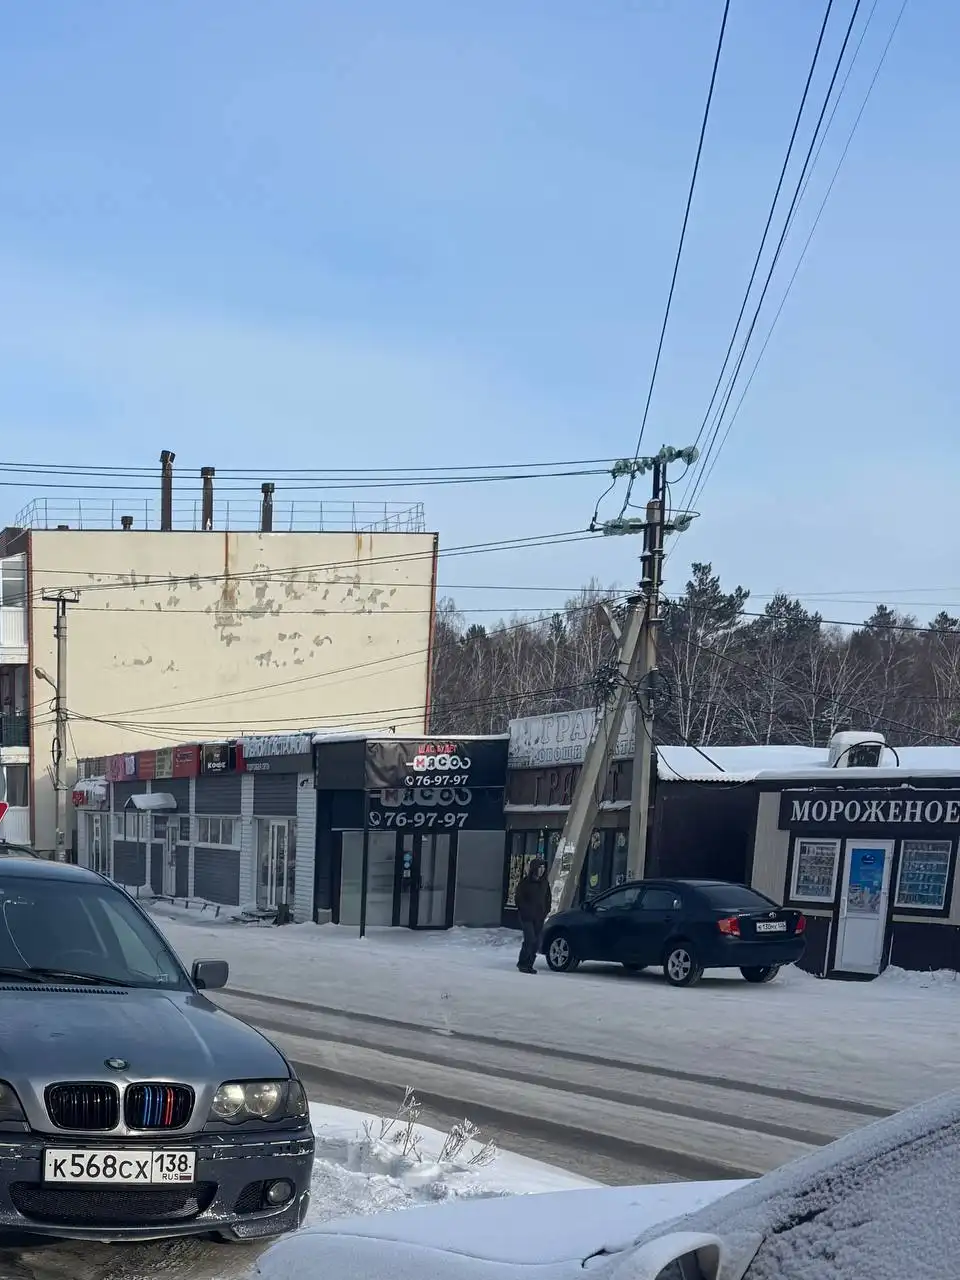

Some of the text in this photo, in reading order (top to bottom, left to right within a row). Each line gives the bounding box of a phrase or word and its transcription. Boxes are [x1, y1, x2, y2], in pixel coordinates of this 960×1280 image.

[415, 775, 469, 786] 76-97-97
[790, 800, 960, 823] МОРОЖЕНОЕ
[384, 812, 469, 828] 76-97-97
[53, 1154, 188, 1179] К568СХ 138
[162, 1173, 179, 1181] RUS
